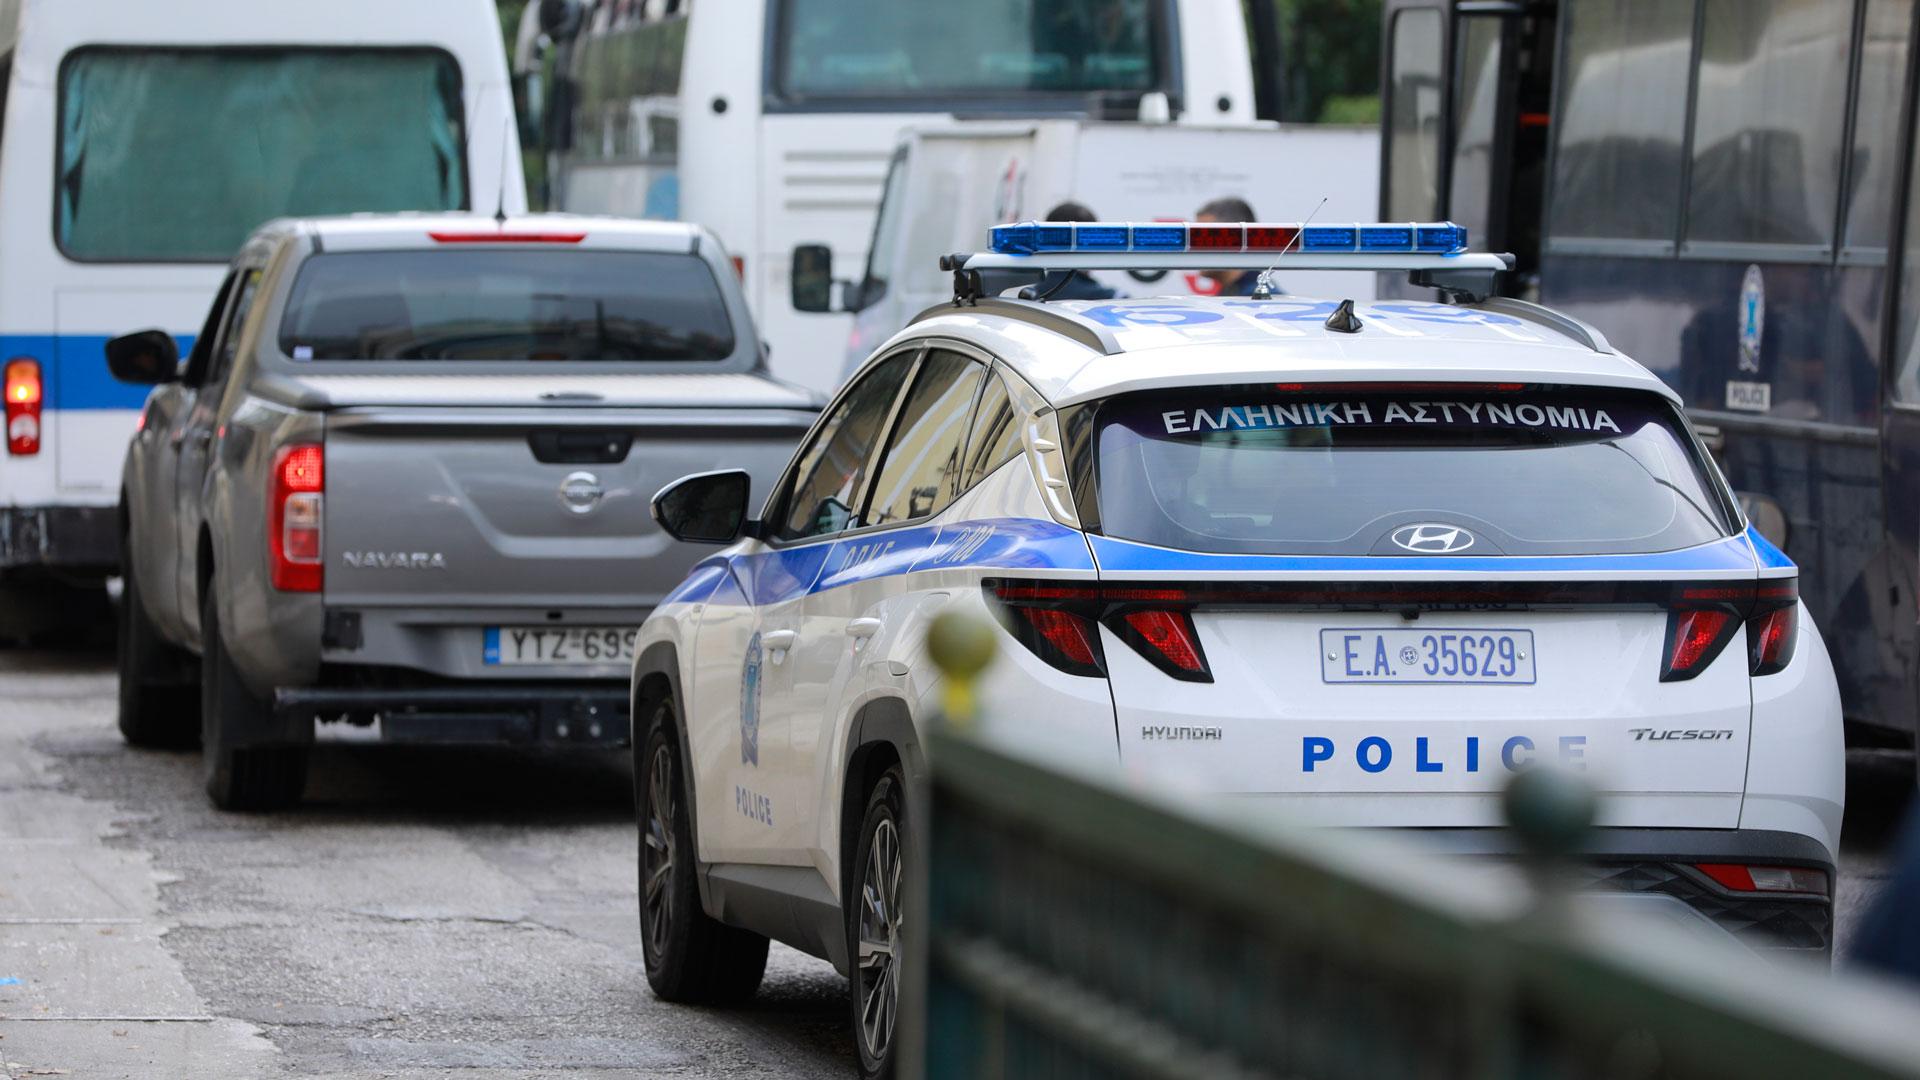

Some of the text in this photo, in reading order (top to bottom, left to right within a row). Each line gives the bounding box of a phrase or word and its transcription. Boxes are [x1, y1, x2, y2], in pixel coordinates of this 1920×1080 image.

[1161, 402, 1622, 434] ΕΛΛΗΝΙΚΗ ΑΣΤΥΝΟΜΙΑ
[343, 551, 446, 568] NAVARA
[1421, 635, 1516, 677] 35629
[1142, 726, 1222, 740] HYUNDAI
[1302, 736, 1587, 773] POLICE
[736, 785, 773, 826] POLICE
